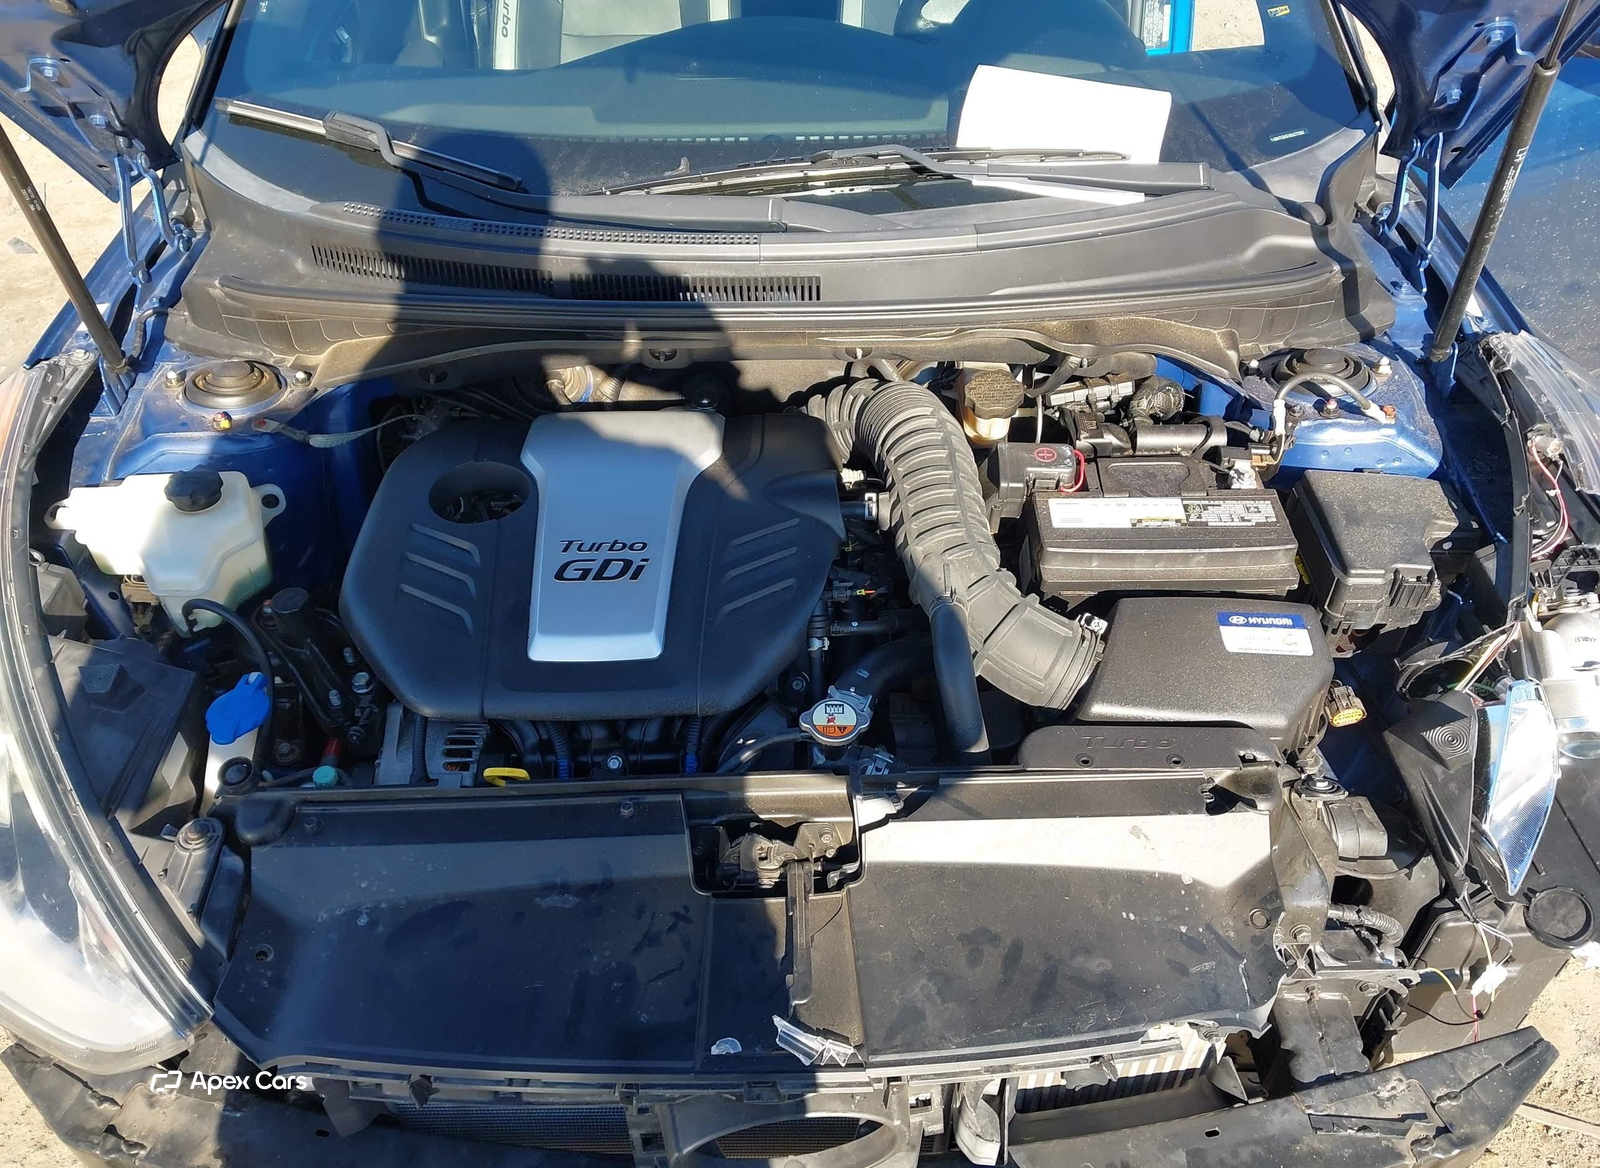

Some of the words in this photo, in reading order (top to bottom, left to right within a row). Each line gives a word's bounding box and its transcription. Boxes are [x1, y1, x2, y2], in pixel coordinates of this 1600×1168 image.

[560, 539, 648, 554] Turbo
[553, 558, 650, 582] GDi
[1247, 616, 1293, 626] HYUNDAI
[1082, 736, 1175, 750] Turbo
